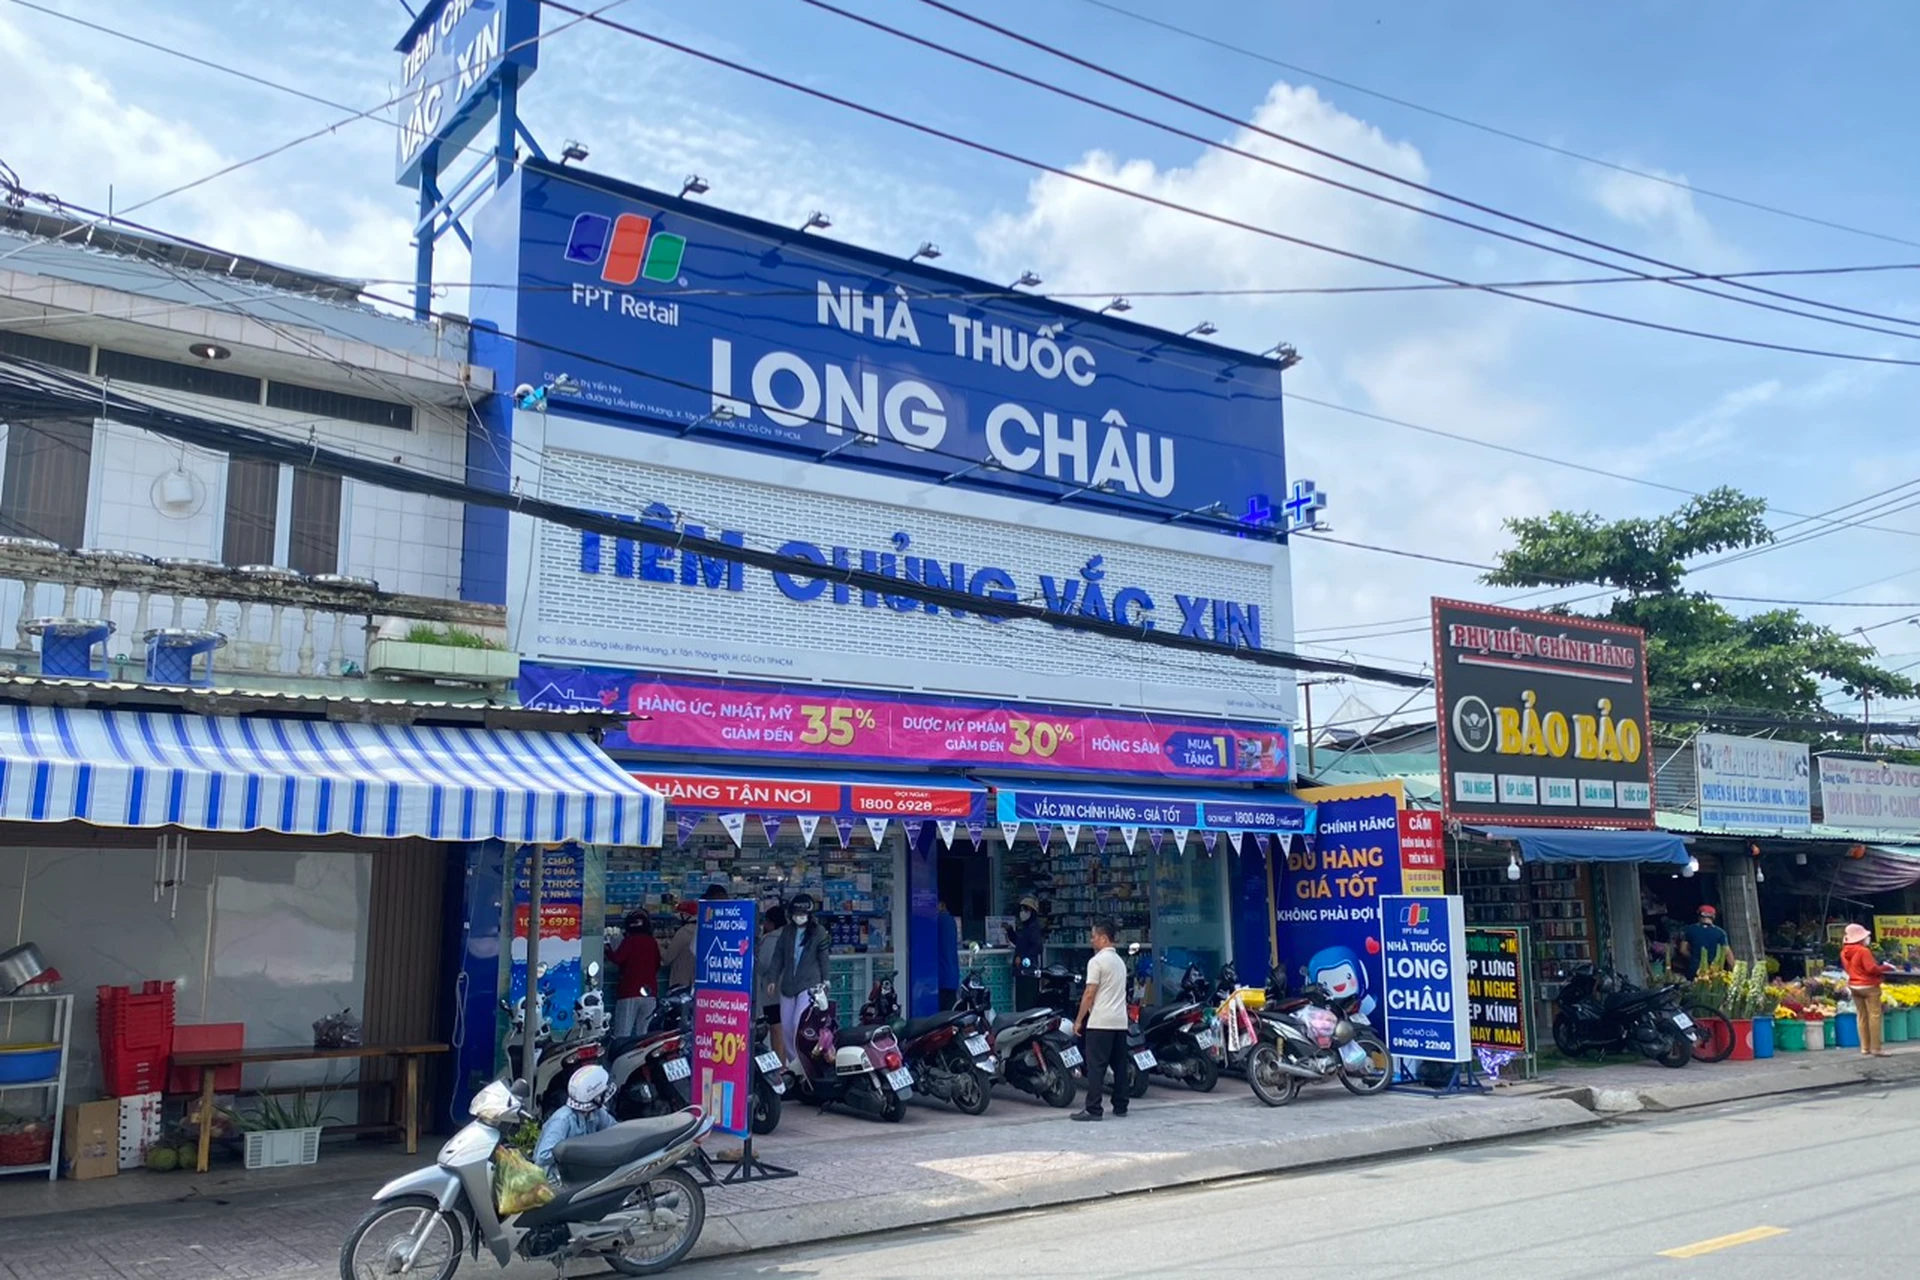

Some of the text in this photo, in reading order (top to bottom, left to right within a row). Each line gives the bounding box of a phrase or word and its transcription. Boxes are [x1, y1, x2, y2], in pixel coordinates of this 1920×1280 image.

[404, 23, 435, 88] TIÊM
[400, 10, 500, 164] VẮC XIN
[573, 282, 679, 327] FPT Retail
[816, 280, 1097, 387] NHÀ THUỐC
[711, 338, 1176, 498] LONG CHÂU
[580, 501, 744, 592] TIÊM
[773, 530, 1018, 625] CHỦNG
[1174, 593, 1262, 651] XIN
[1449, 623, 1491, 655] PHỤ
[1492, 626, 1535, 659] KIỆN
[1537, 633, 1592, 662] CHÍNH
[638, 694, 875, 748] HÀNG ÚC, NHẬT, MỸ 35%
[1493, 689, 1570, 759] BẢO
[1572, 697, 1642, 764] BẢO
[722, 723, 793, 742] GIẢM ĐẾN
[902, 715, 1075, 757] DƯỢC MỸ PHẨM 30%
[945, 735, 1005, 753] GIẢM ĐẾN
[1091, 734, 1160, 754] HỒNG SÂM
[1187, 736, 1228, 768] MUA 1
[1183, 750, 1215, 768] TẶNG
[654, 781, 811, 804] HÀNG TẬN NƠI
[859, 797, 893, 810] 1800
[896, 799, 932, 811] 6928
[1034, 799, 1057, 817] VẮC
[1058, 803, 1075, 818] XIN
[1076, 801, 1107, 819] CHÍNH
[1144, 804, 1162, 822] GIÁ
[1162, 804, 1181, 823] TỐT
[1234, 811, 1253, 825] 1800
[1255, 812, 1276, 826] 6928
[1320, 815, 1396, 836] CHÍNH HÃNG
[1408, 813, 1432, 830] CẤM
[1322, 844, 1384, 870] HÀNG
[547, 878, 580, 889] THUỐC
[1296, 870, 1378, 899] GIÁ TỐT
[548, 917, 576, 926] 6928
[713, 919, 730, 931] LONG
[730, 917, 748, 931] CHÂU
[1277, 907, 1318, 921] KHÔNG
[1320, 905, 1349, 920] PHẢI
[1351, 906, 1374, 922] ĐỢI
[1386, 938, 1447, 953] NHÀ THUỐC
[709, 953, 744, 969] GIA ĐÌNH
[1387, 957, 1449, 980] LONG
[1481, 959, 1516, 977] LƯNG
[709, 971, 721, 983] VUI
[1388, 985, 1451, 1012] CHÂU
[1483, 980, 1517, 998] NGHE
[1485, 1001, 1517, 1023] KÍNH
[1425, 1039, 1451, 1050] 22h00
[1494, 1026, 1521, 1045] MÀN
[695, 1032, 712, 1047] GIẢM
[712, 1031, 747, 1065] 30%
